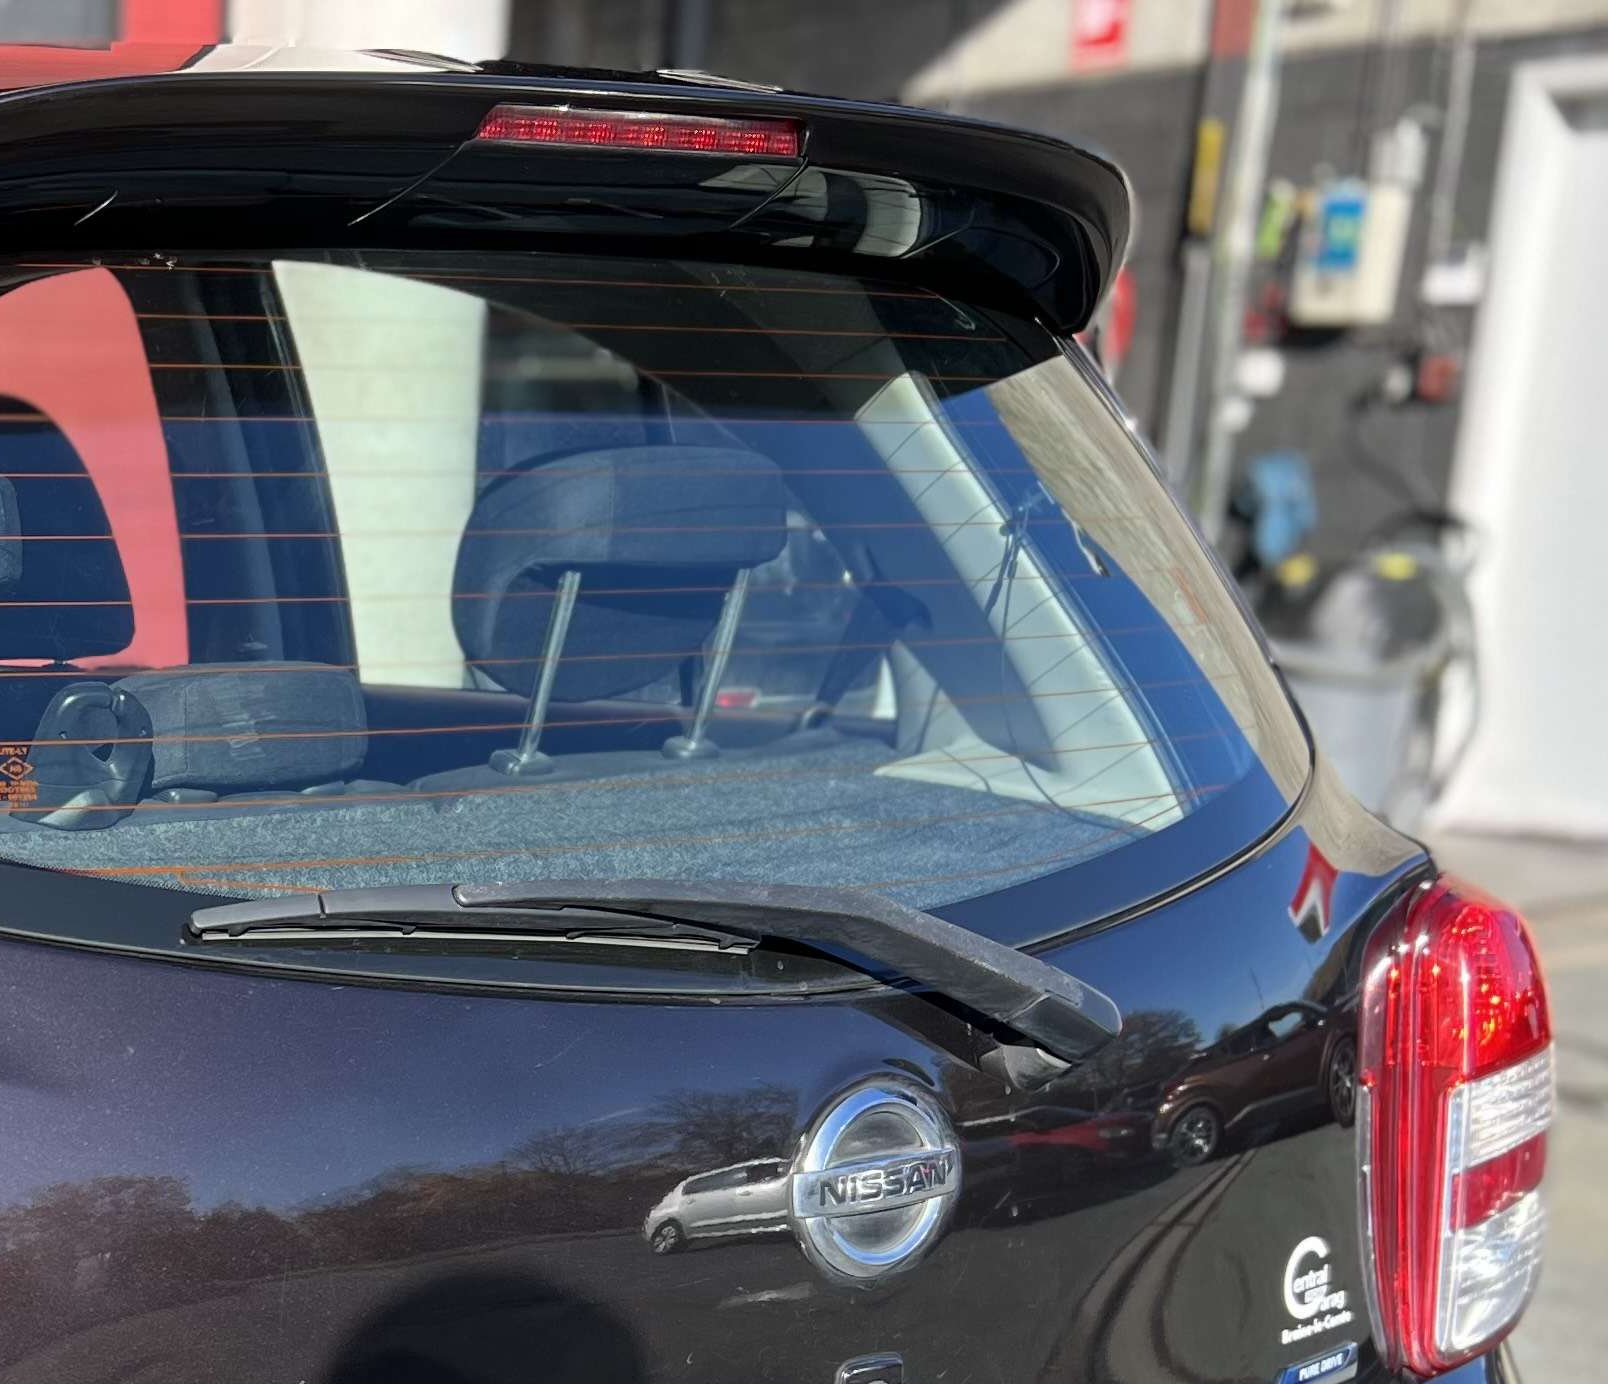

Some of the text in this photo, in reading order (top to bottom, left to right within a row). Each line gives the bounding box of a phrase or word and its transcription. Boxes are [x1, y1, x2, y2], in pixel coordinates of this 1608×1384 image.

[819, 1157, 952, 1206] NISSAN
[1299, 1353, 1344, 1381] PURE DRIVE
